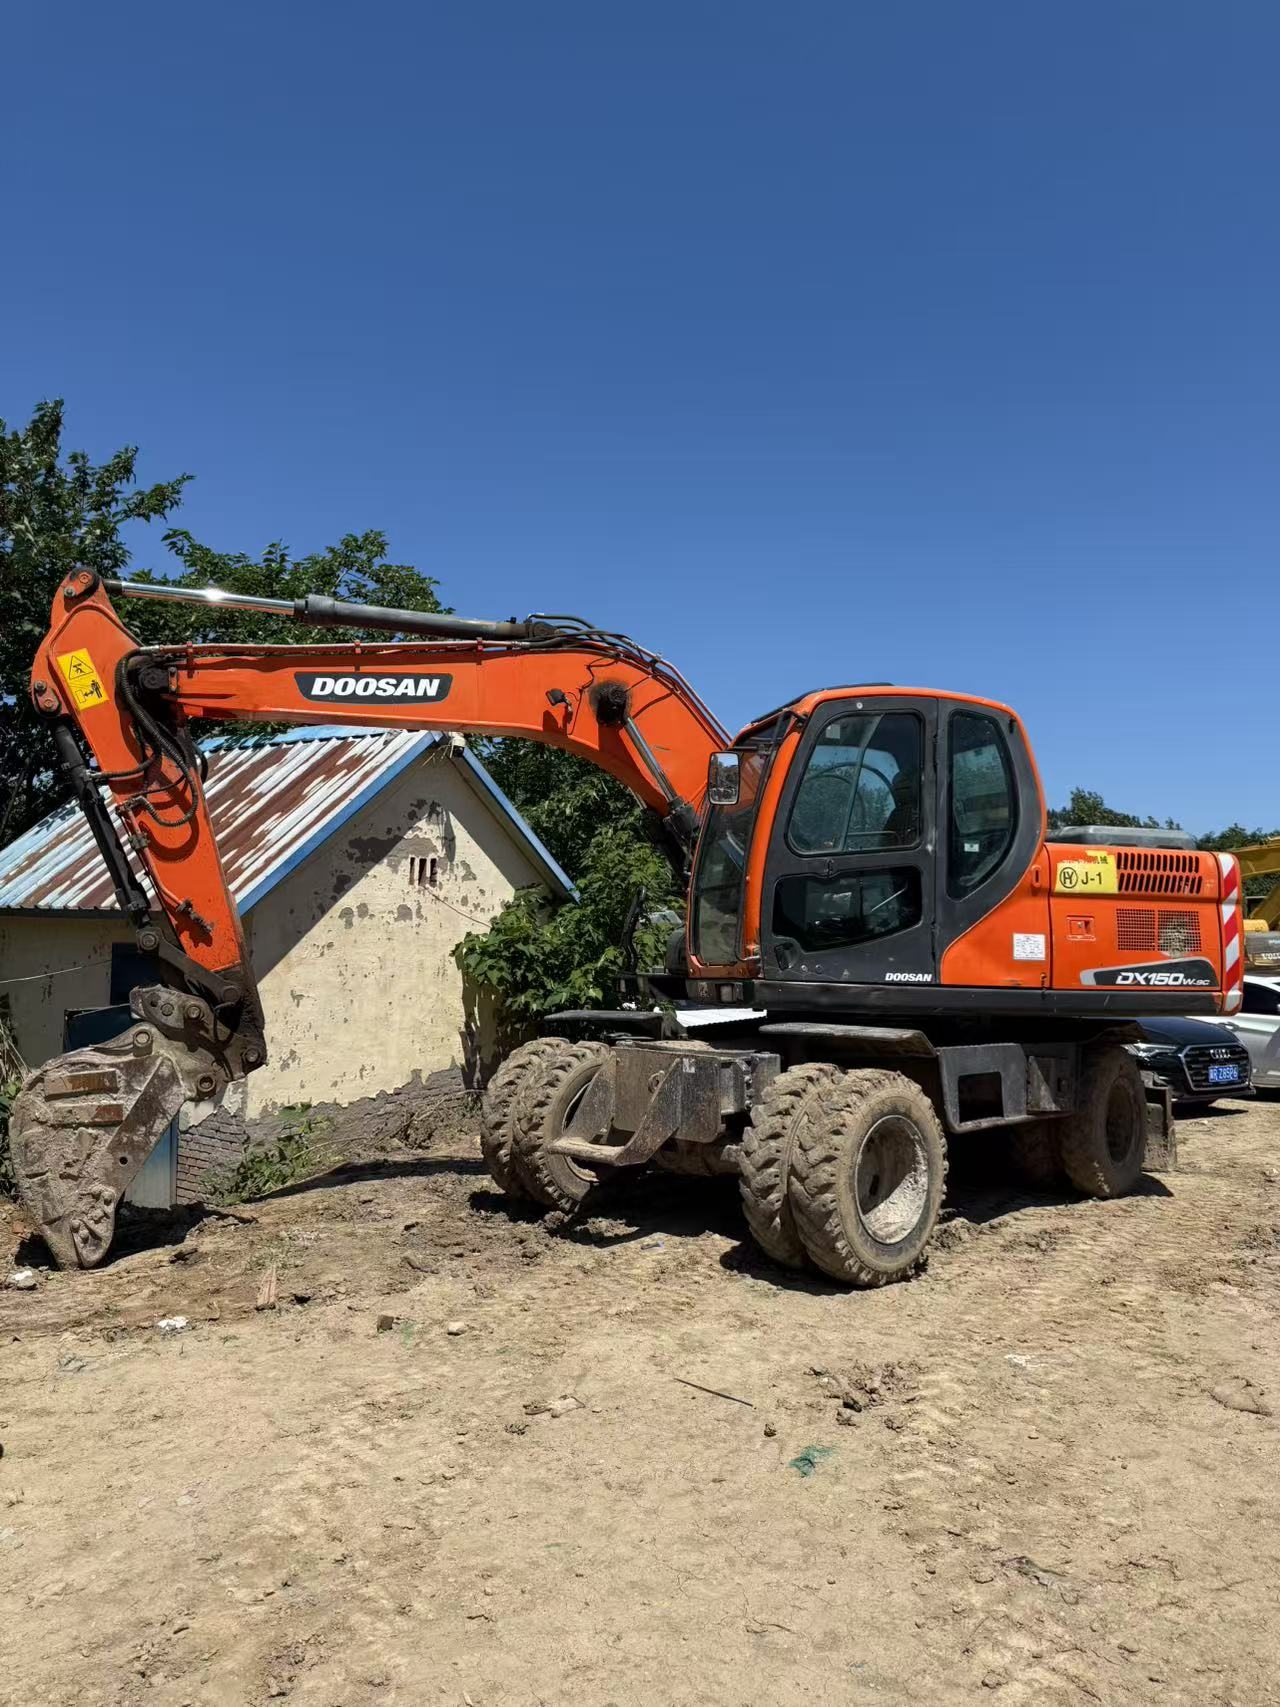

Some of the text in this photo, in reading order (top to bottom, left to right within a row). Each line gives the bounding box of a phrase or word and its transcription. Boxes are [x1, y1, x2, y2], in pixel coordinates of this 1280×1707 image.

[311, 677, 440, 697] DOOSAN
[1081, 871, 1103, 885] J-1
[885, 972, 932, 982] DOOSAN
